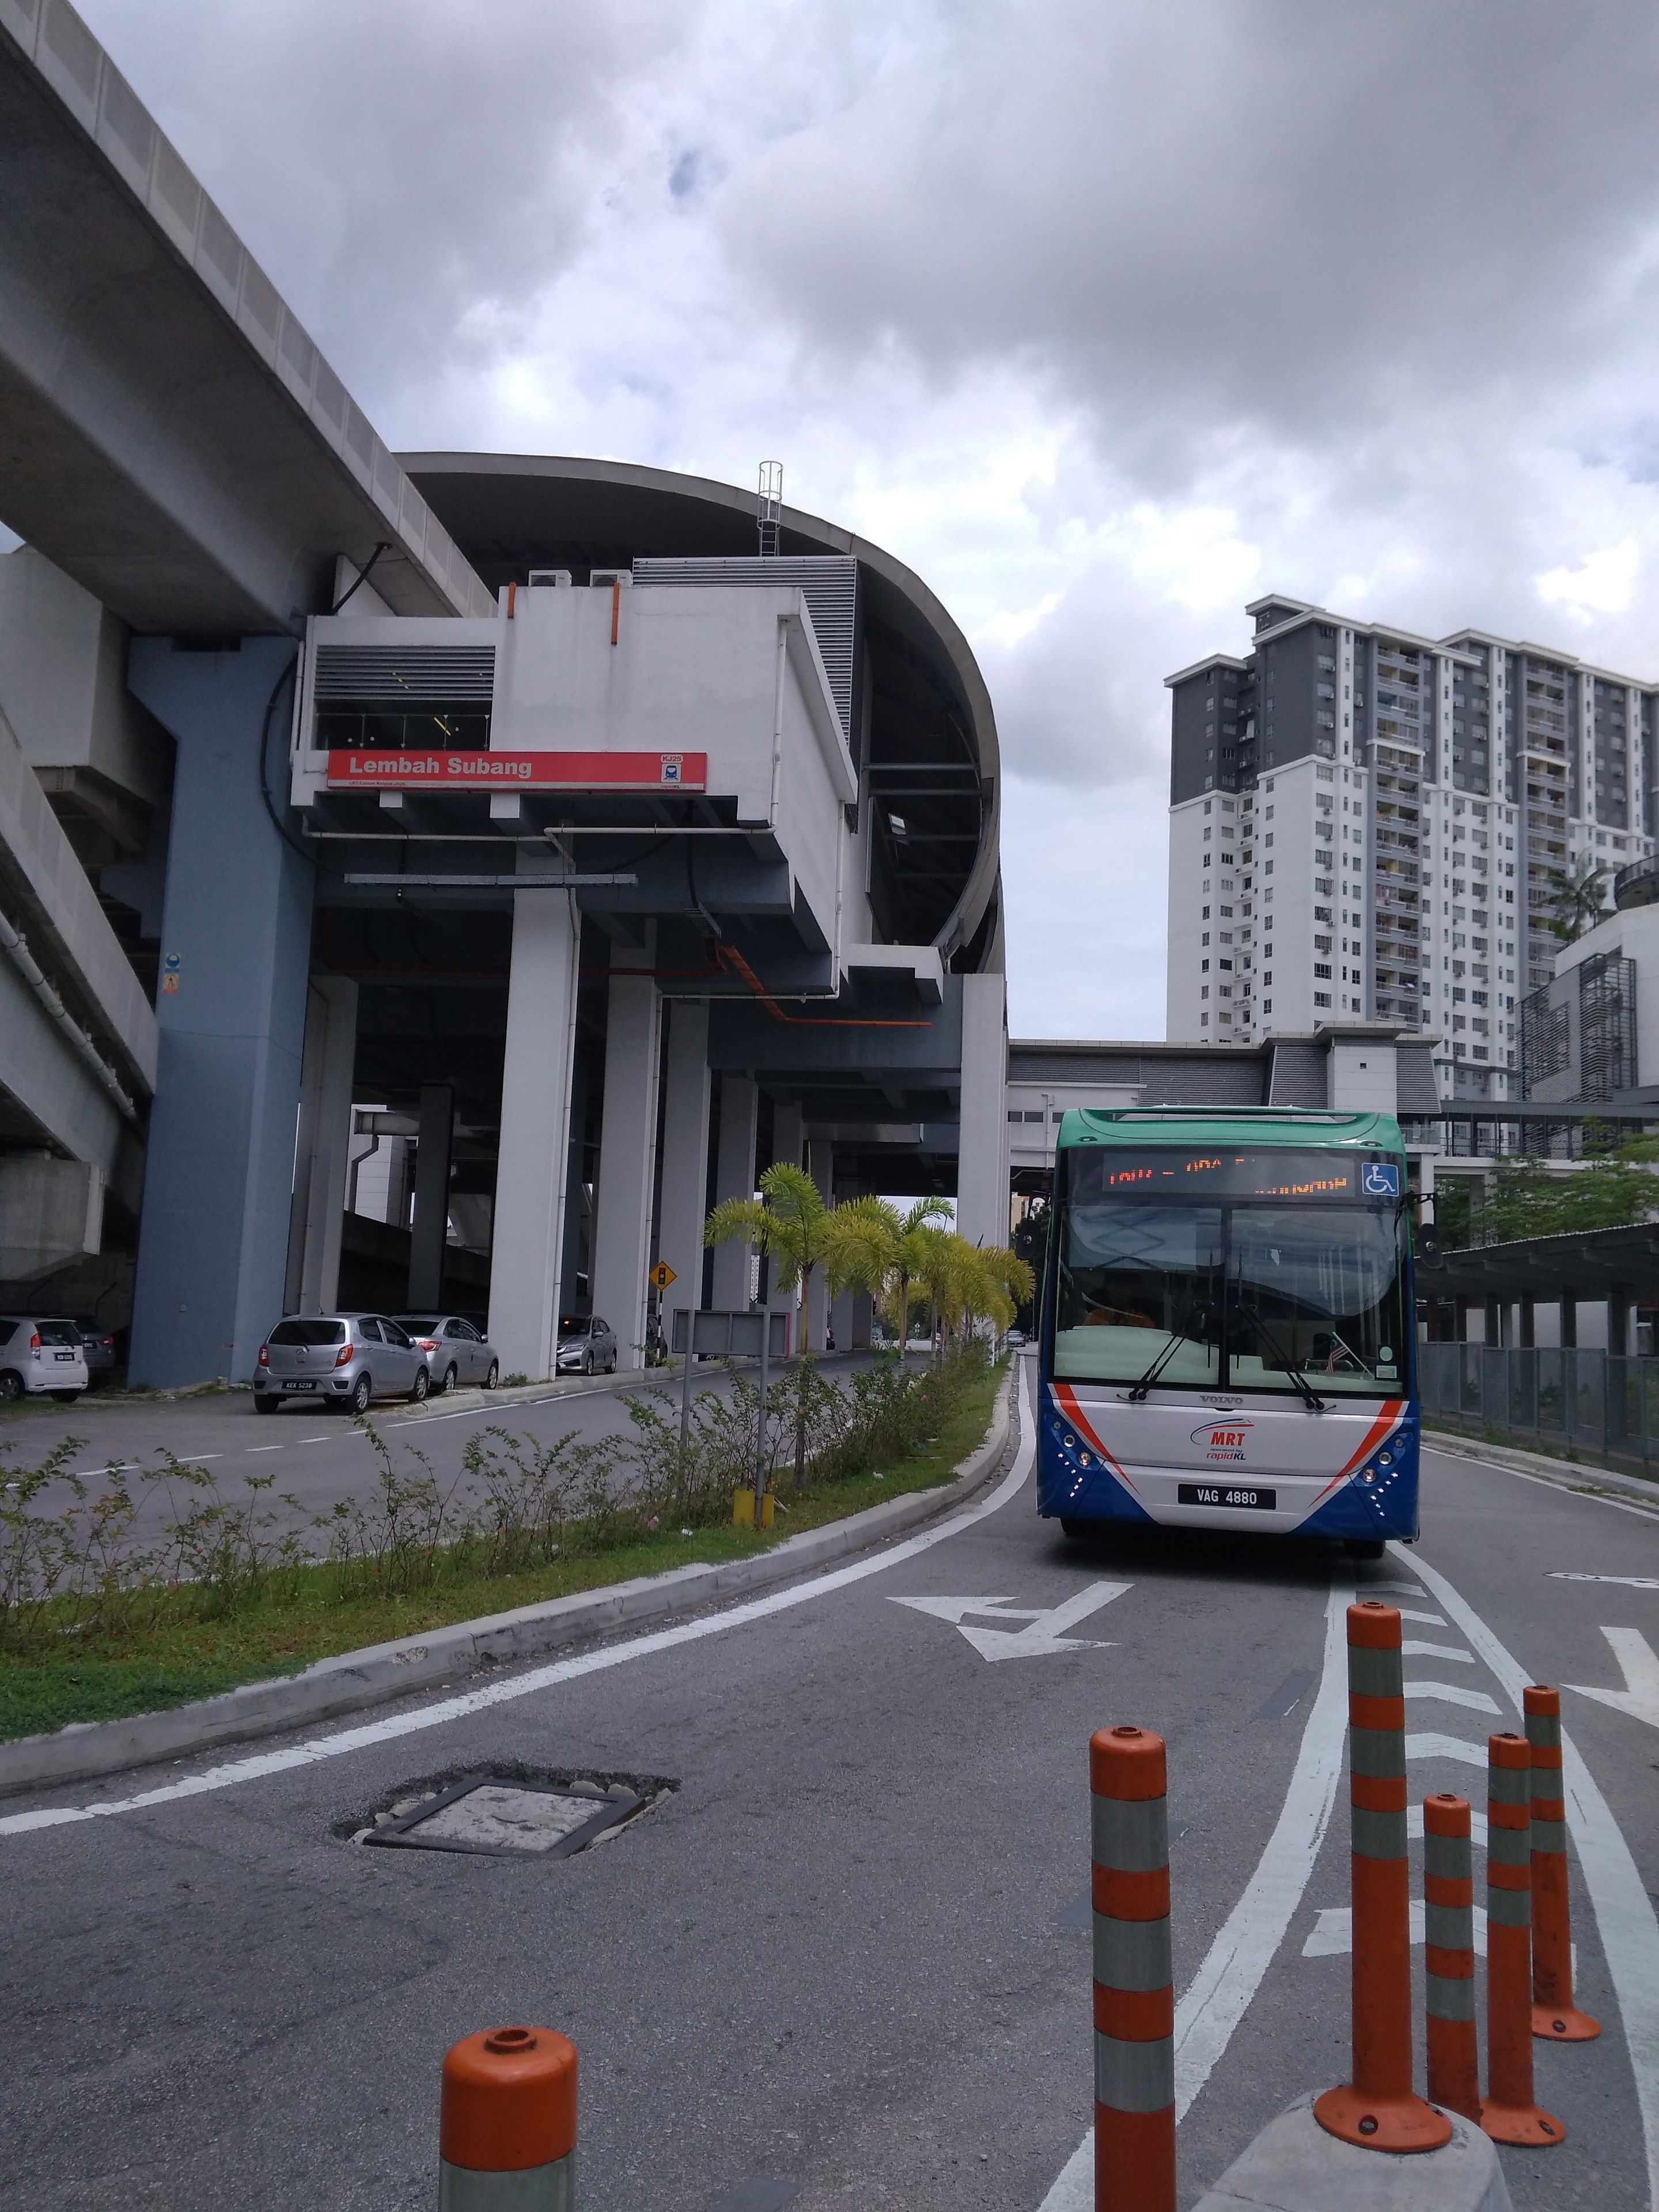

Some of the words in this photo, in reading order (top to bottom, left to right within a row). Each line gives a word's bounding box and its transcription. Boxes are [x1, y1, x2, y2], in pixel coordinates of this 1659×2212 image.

[350, 757, 439, 774] Lembah
[447, 758, 532, 778] Subang
[1199, 1395, 1243, 1404] VOLVO
[1210, 1431, 1245, 1446] MRT
[1197, 1488, 1219, 1502] VAG
[1225, 1491, 1257, 1505] 4880
